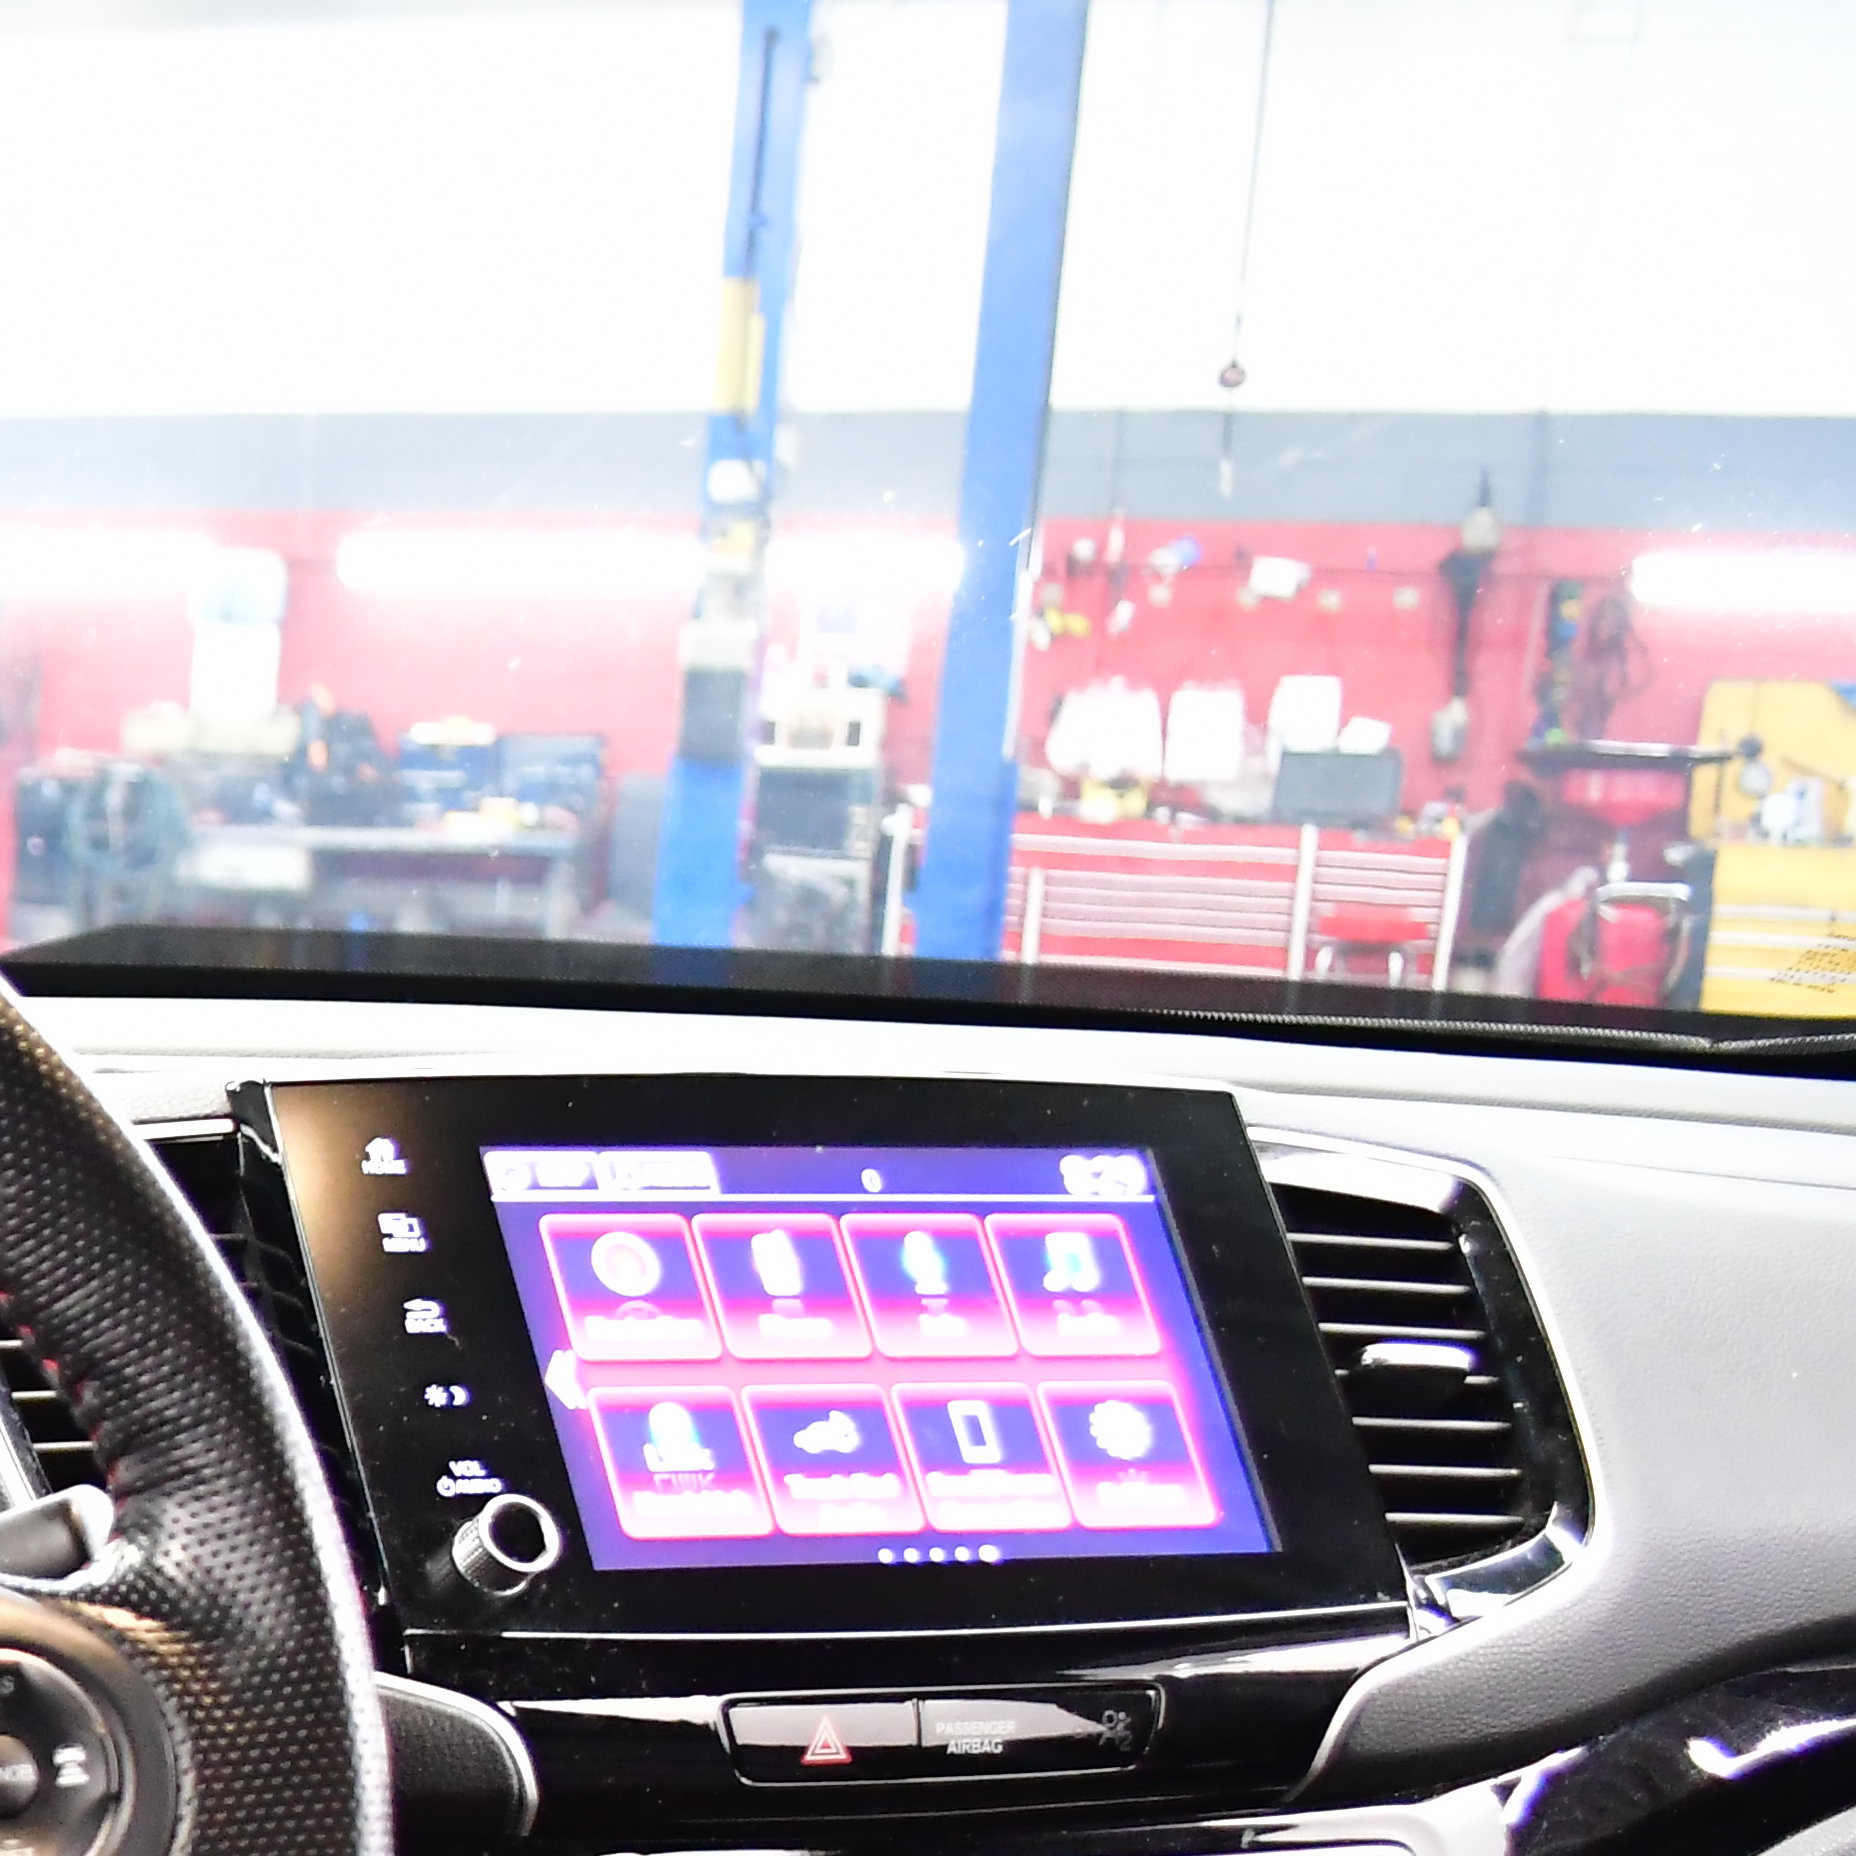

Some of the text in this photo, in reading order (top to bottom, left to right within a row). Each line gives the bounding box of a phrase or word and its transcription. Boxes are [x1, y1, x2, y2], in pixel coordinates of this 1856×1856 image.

[449, 1460, 486, 1477] VOL
[935, 1720, 1016, 1736] PASSENGER
[946, 1739, 1004, 1755] AIRBAG
